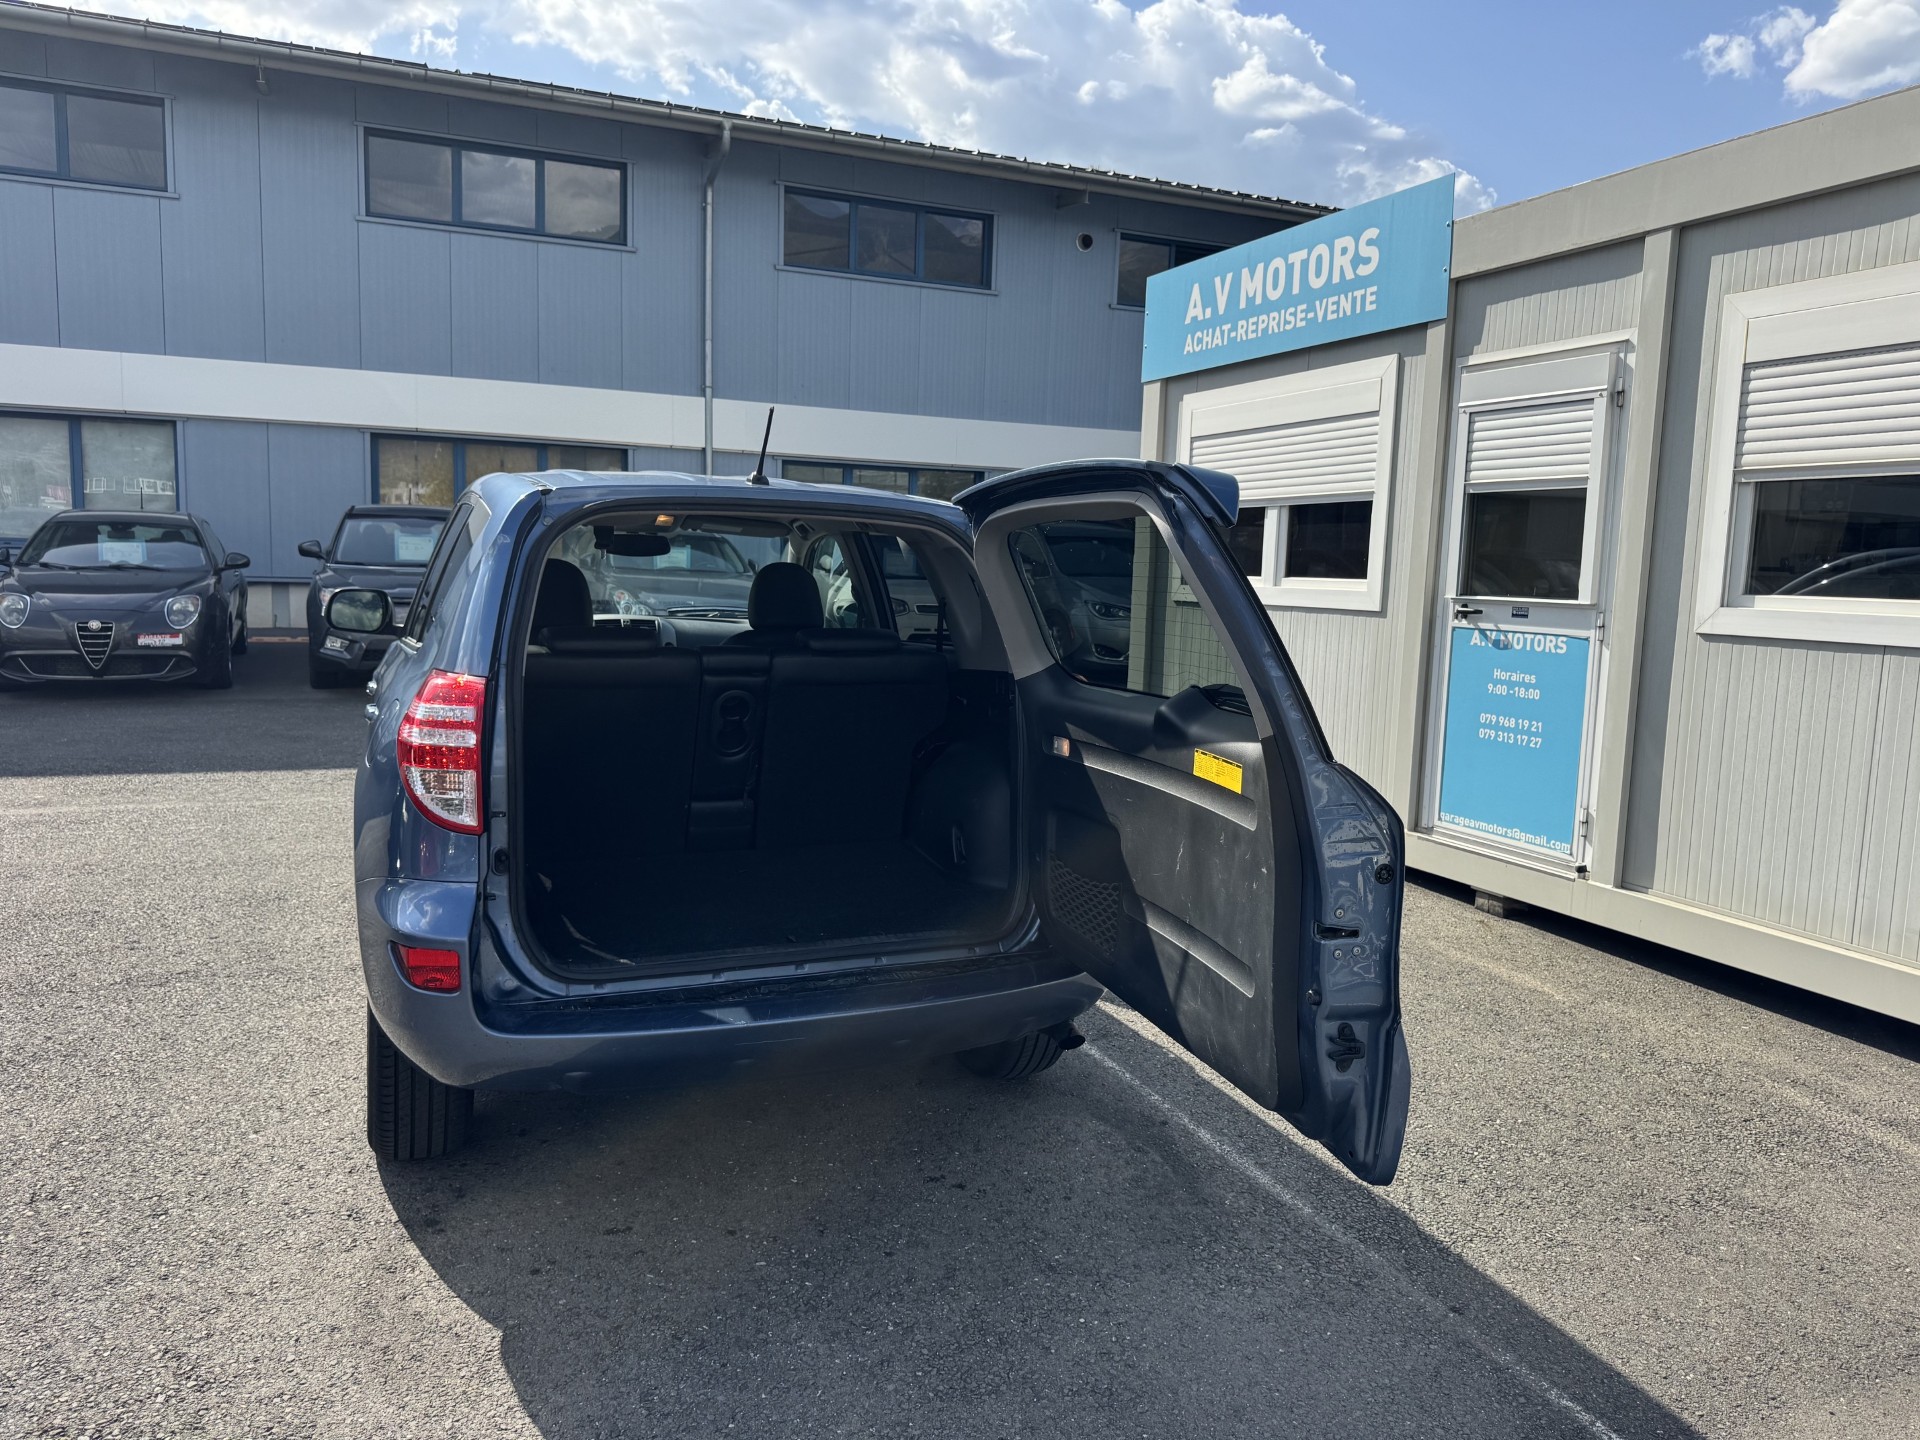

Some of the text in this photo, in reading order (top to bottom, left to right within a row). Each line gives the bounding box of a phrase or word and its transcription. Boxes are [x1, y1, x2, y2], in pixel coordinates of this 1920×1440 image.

[1184, 227, 1380, 325] A.V MOTORS
[1184, 286, 1377, 355] ACHAT-REPRISE-VENTE
[1470, 629, 1567, 654] A.V MOTORS
[1493, 668, 1536, 684] Horaires
[1487, 683, 1507, 695] 9:00
[1480, 713, 1542, 733] 079 968 19 21
[1479, 728, 1542, 748] 079 313 17 27
[1440, 811, 1570, 853] garageavmotors@gmail.com
